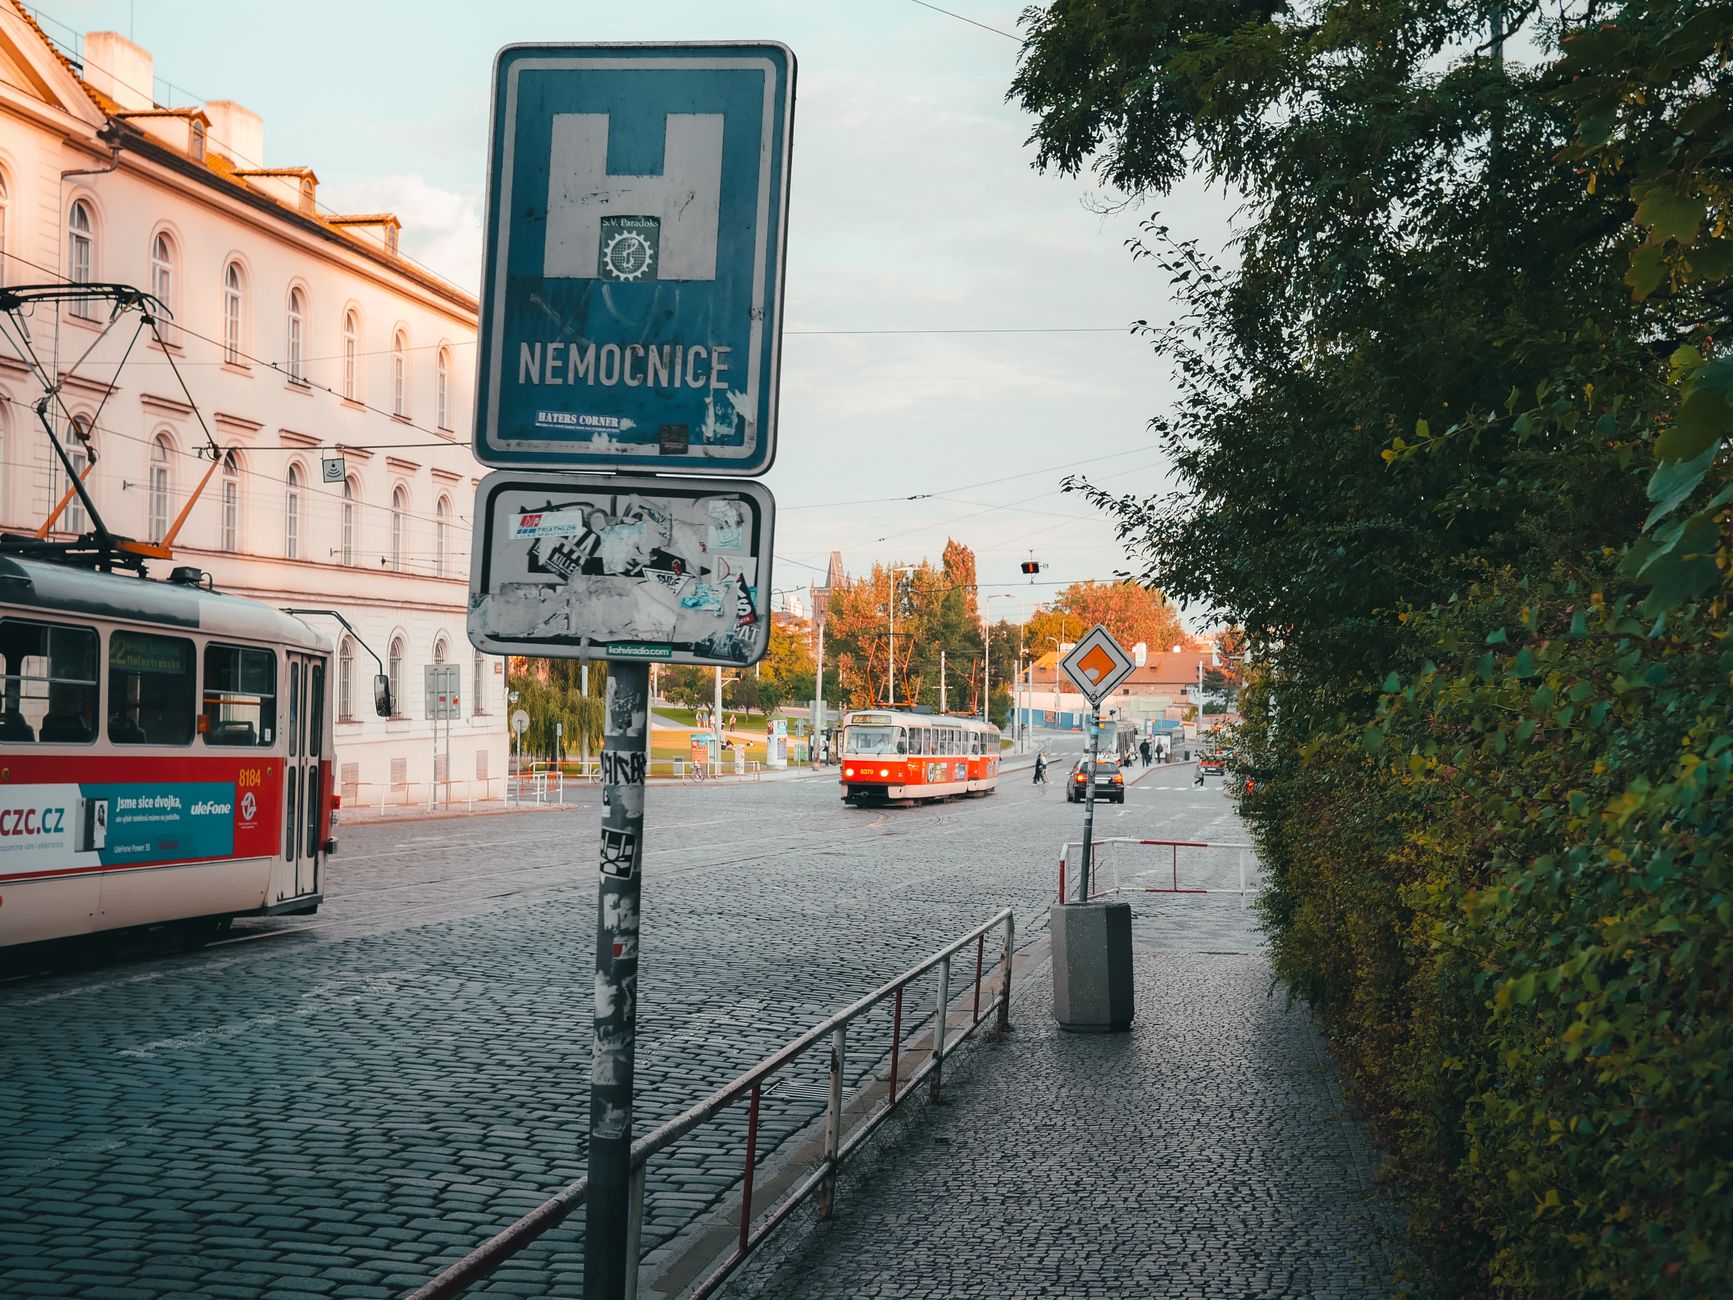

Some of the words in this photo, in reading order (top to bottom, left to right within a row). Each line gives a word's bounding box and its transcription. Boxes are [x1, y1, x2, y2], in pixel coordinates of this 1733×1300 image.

[544, 113, 724, 280] H
[620, 218, 660, 228] Paradoks
[518, 342, 732, 389] NEMOCNICE
[538, 411, 577, 425] HATERS
[579, 415, 619, 428] CORNER
[549, 551, 581, 576] KILLE
[608, 646, 670, 656] kohviradio.com
[239, 769, 261, 787] 8184
[116, 796, 137, 813] Jsme
[138, 796, 154, 809] sice
[154, 795, 182, 810] dvojka,
[0, 808, 65, 836] CZC.CZ
